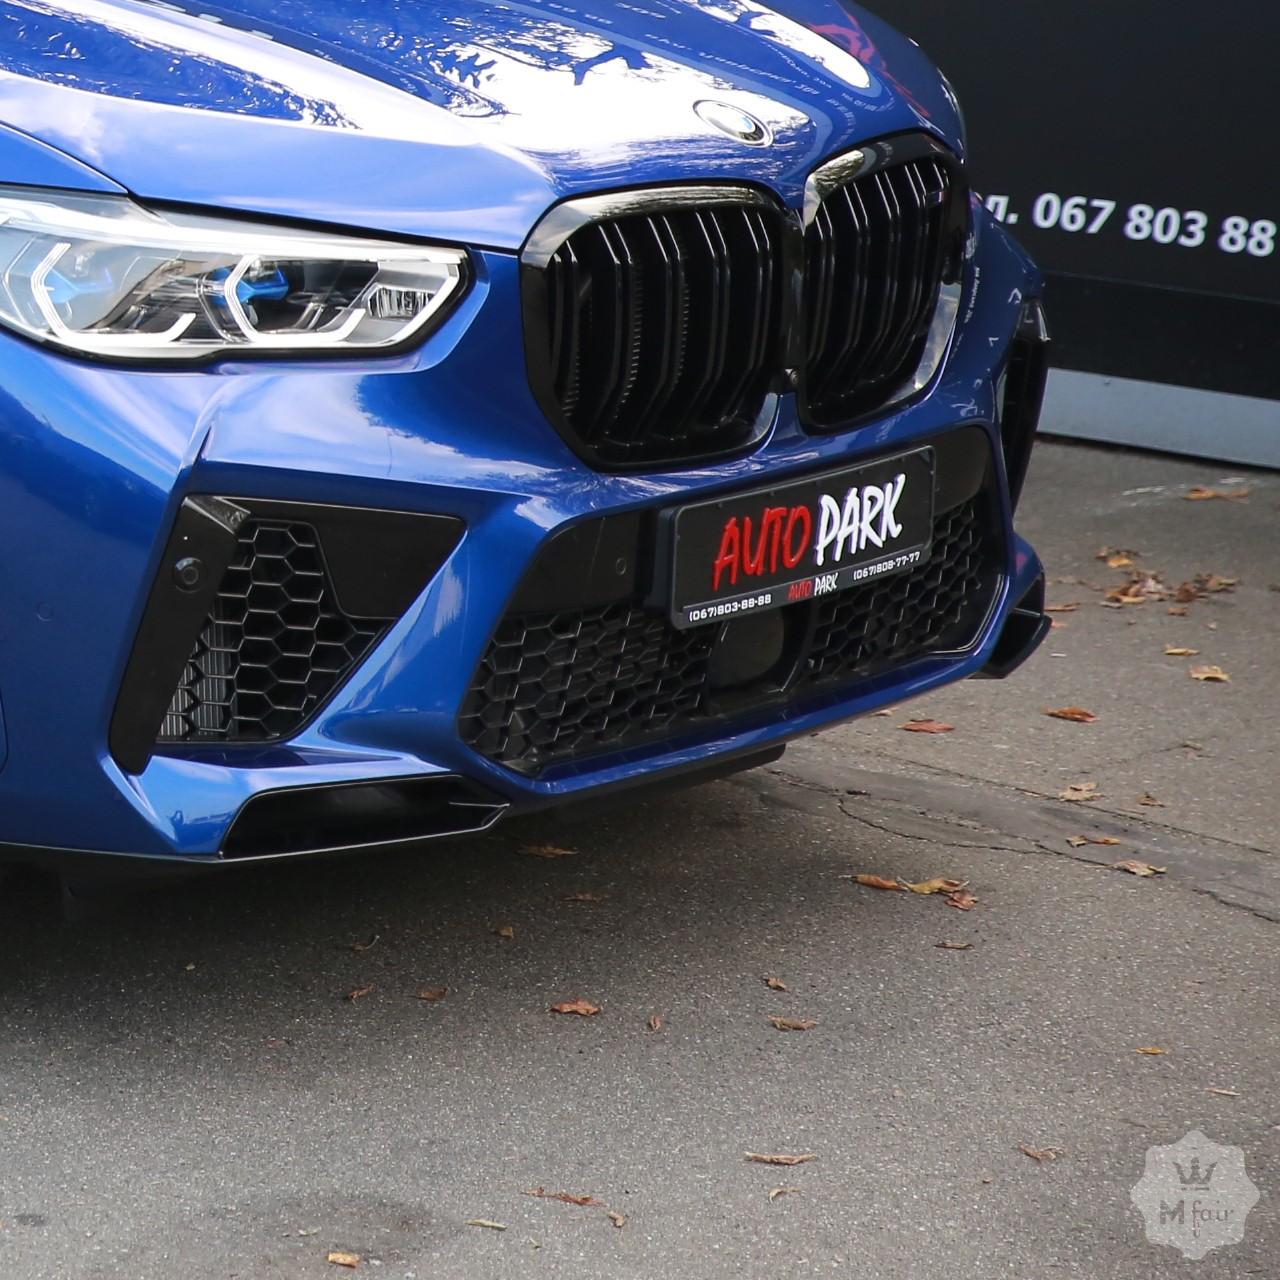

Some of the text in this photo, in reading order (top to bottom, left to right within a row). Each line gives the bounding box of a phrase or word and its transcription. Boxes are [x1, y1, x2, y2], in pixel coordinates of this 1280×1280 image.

[1032, 192, 1117, 234] 067
[1123, 203, 1208, 248] 803
[1217, 215, 1277, 257] 88
